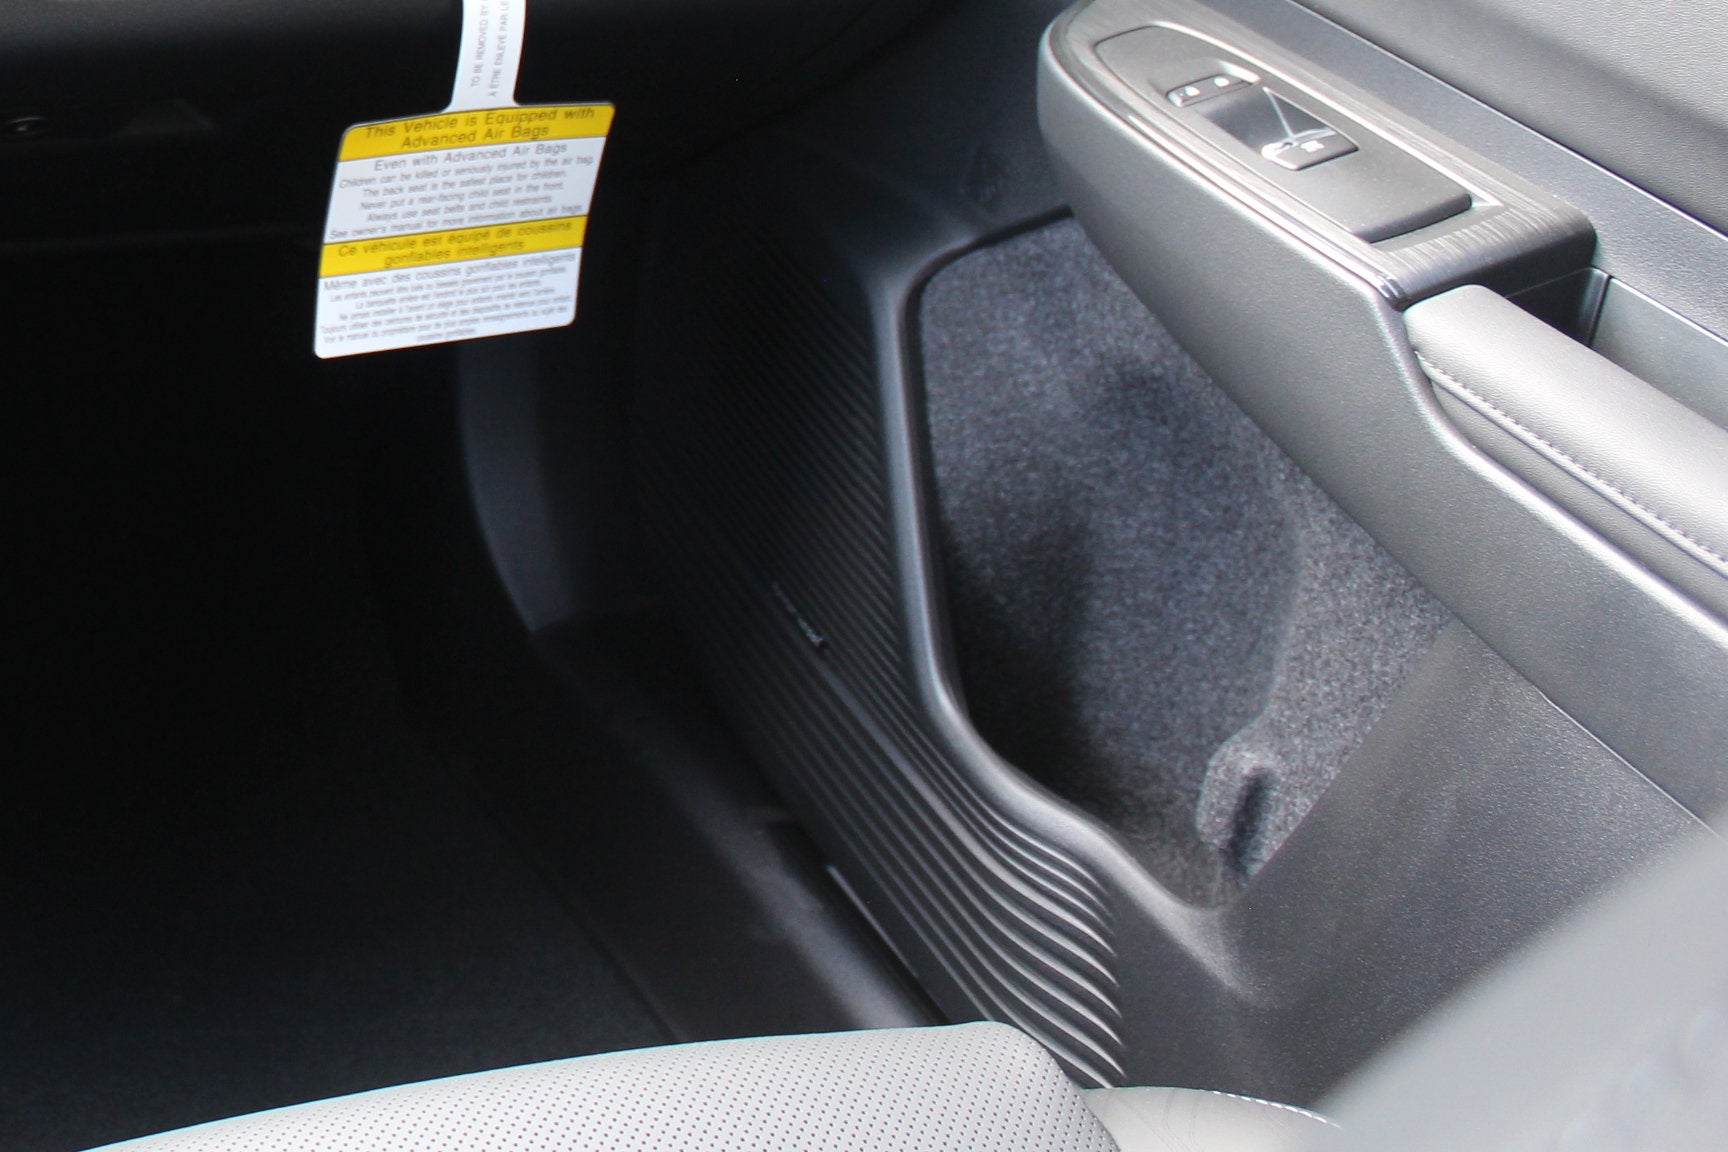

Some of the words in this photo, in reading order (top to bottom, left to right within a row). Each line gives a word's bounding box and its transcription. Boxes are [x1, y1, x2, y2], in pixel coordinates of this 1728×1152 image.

[366, 125, 396, 138] This
[403, 118, 458, 132] Vehicle
[465, 115, 478, 126] is
[485, 108, 558, 126] Equipped
[564, 108, 596, 120] with
[401, 132, 477, 147] Advanced
[485, 127, 505, 139] Air
[511, 124, 550, 141] Bags
[374, 158, 407, 170] Even
[413, 154, 438, 165] with
[445, 149, 507, 162] Advanced
[513, 146, 530, 154] Air
[535, 143, 568, 155] Bags
[338, 244, 358, 257] Ce
